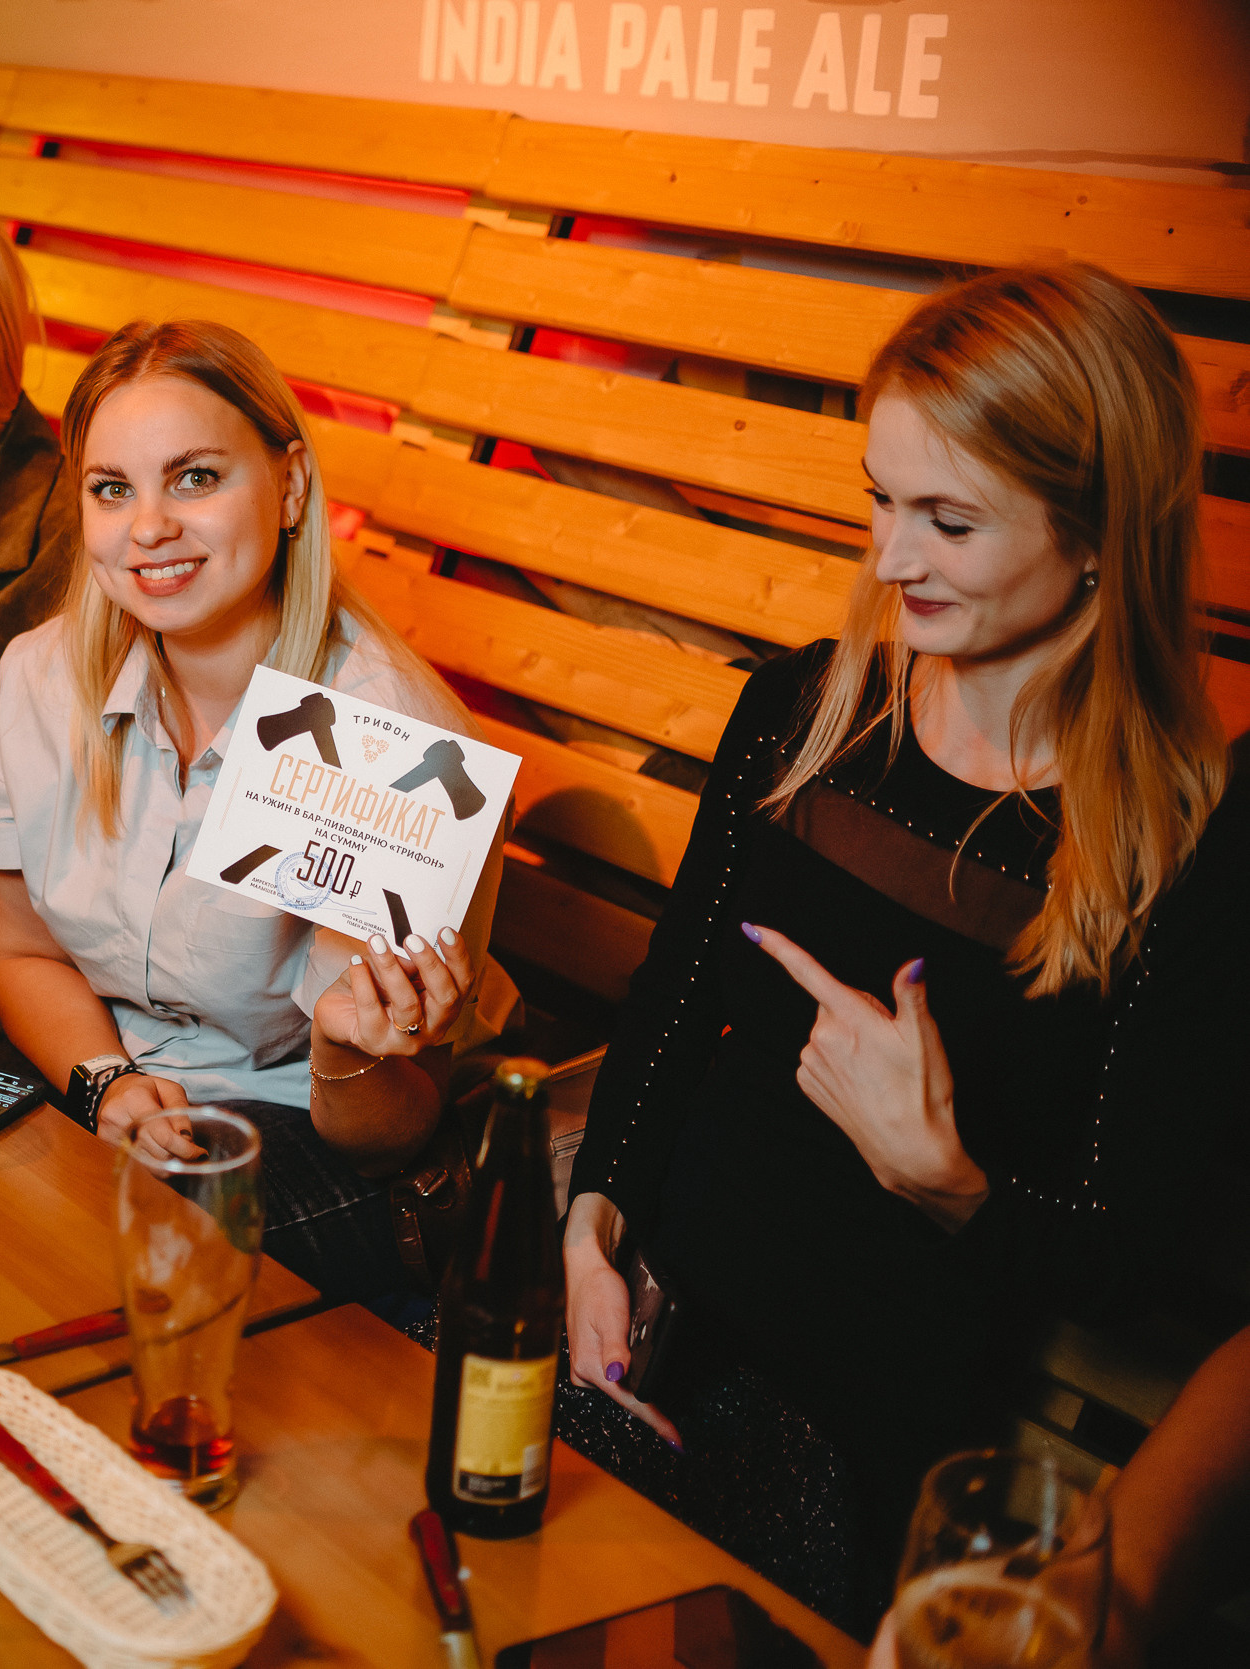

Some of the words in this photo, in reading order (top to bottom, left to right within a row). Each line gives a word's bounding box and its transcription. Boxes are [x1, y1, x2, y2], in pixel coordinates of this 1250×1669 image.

[419, 0, 582, 91] INDIA
[603, 3, 776, 107] PALE
[792, 12, 949, 119] ALE
[353, 715, 411, 742] ТРИФОН
[245, 790, 259, 801] НА
[262, 795, 292, 813] УЖИН
[294, 806, 301, 816] В
[302, 810, 388, 849] БАР-ПИВОВАРНЮ
[389, 844, 445, 870] «ТРИФОН»
[269, 753, 446, 850] СЕРТИФИКАТ
[314, 827, 329, 840] НА
[329, 833, 368, 853] СУММУ
